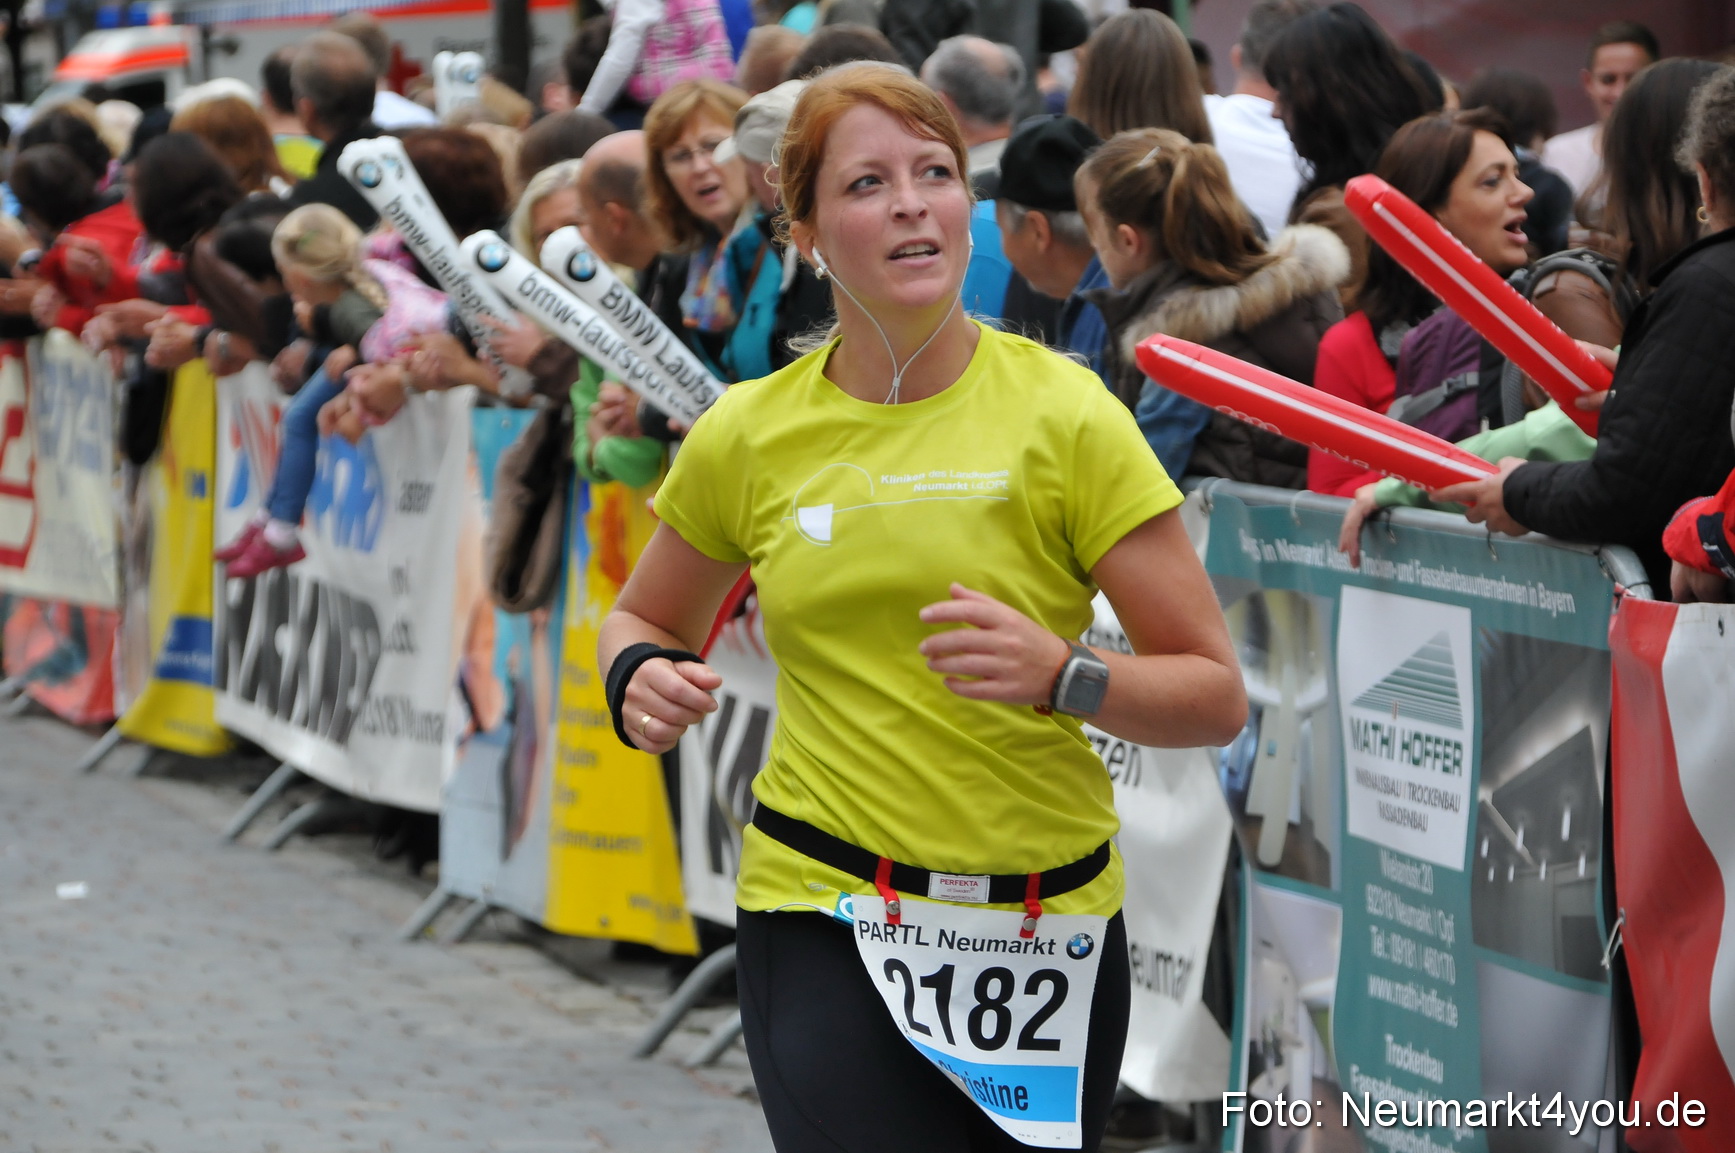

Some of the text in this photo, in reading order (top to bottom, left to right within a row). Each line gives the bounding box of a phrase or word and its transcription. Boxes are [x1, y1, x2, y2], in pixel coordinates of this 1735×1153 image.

[600, 280, 661, 346] BMW
[880, 473, 926, 485] Kliniken
[928, 469, 947, 478] des
[913, 482, 968, 492] Neumarkt
[1537, 582, 1576, 618] Bayern
[1350, 716, 1463, 777] MATHI HOFFER
[1408, 781, 1461, 813] TROCKENBAU
[1378, 800, 1429, 833] FASSADENBAU
[940, 878, 979, 887] PERFEKTA
[858, 920, 1057, 955] PARTL Neumarkt
[883, 957, 1069, 1052] 2182
[1385, 1033, 1443, 1084] Trockenbau
